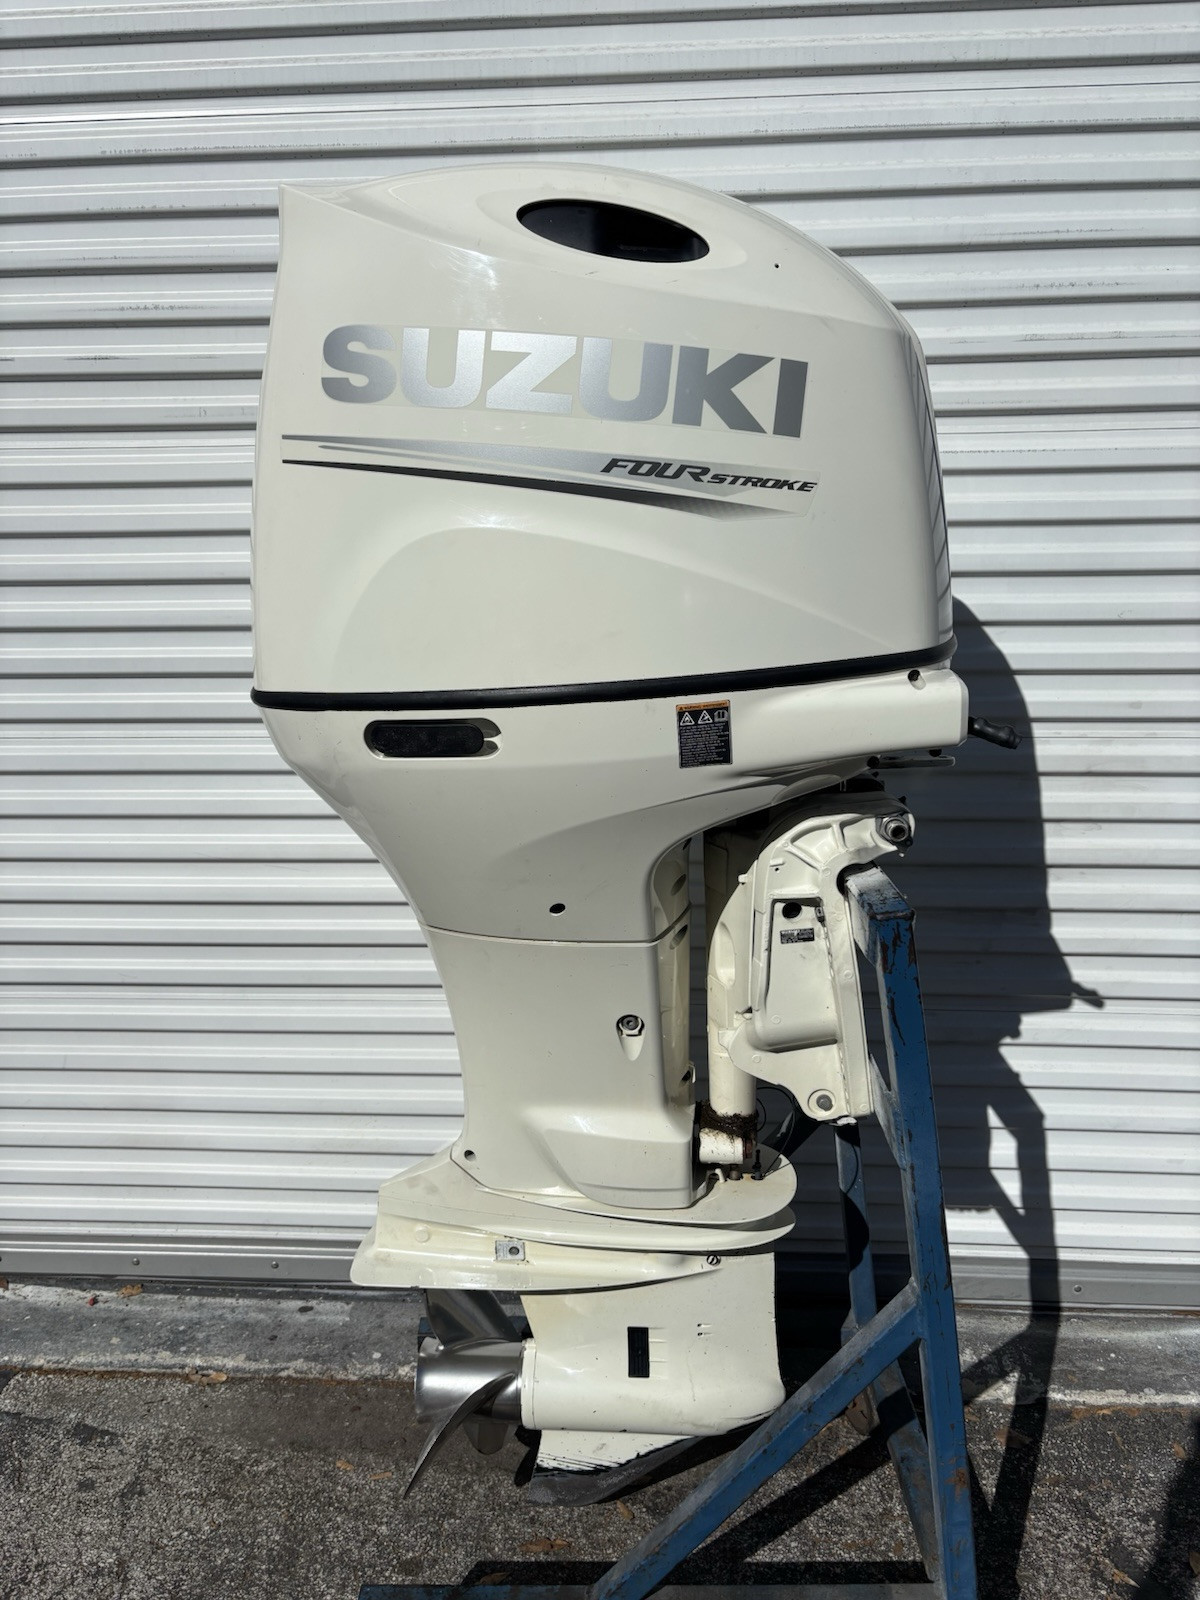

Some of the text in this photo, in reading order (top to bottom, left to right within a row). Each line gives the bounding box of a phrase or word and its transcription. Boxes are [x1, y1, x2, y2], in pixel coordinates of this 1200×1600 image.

[321, 324, 808, 438] SUZUKI
[600, 458, 818, 492] FOUR STROKE
